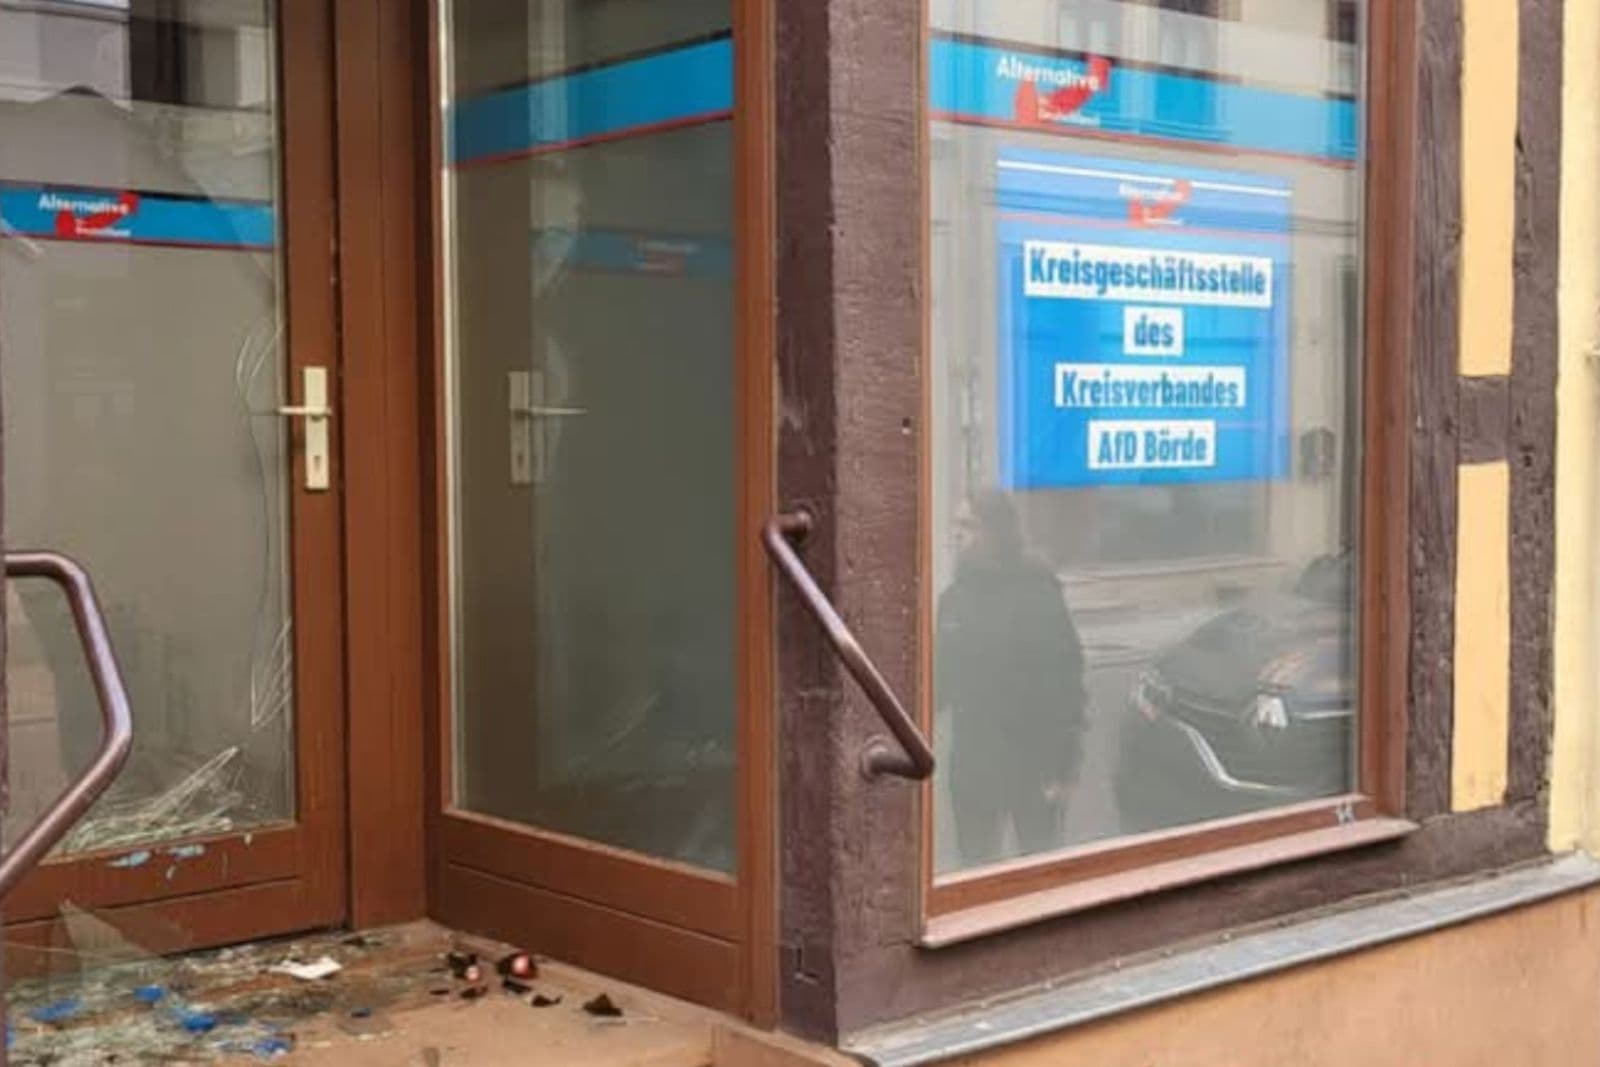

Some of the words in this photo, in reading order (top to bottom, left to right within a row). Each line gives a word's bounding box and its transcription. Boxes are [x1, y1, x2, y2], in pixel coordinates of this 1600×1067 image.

[997, 55, 1099, 91] Alternative
[1029, 248, 1267, 295] Kreisgeschäftsstelle
[1133, 315, 1174, 347] des
[1062, 370, 1239, 404] Kreisverbandes
[1097, 430, 1137, 463] AfD
[1144, 428, 1207, 461] Börde
